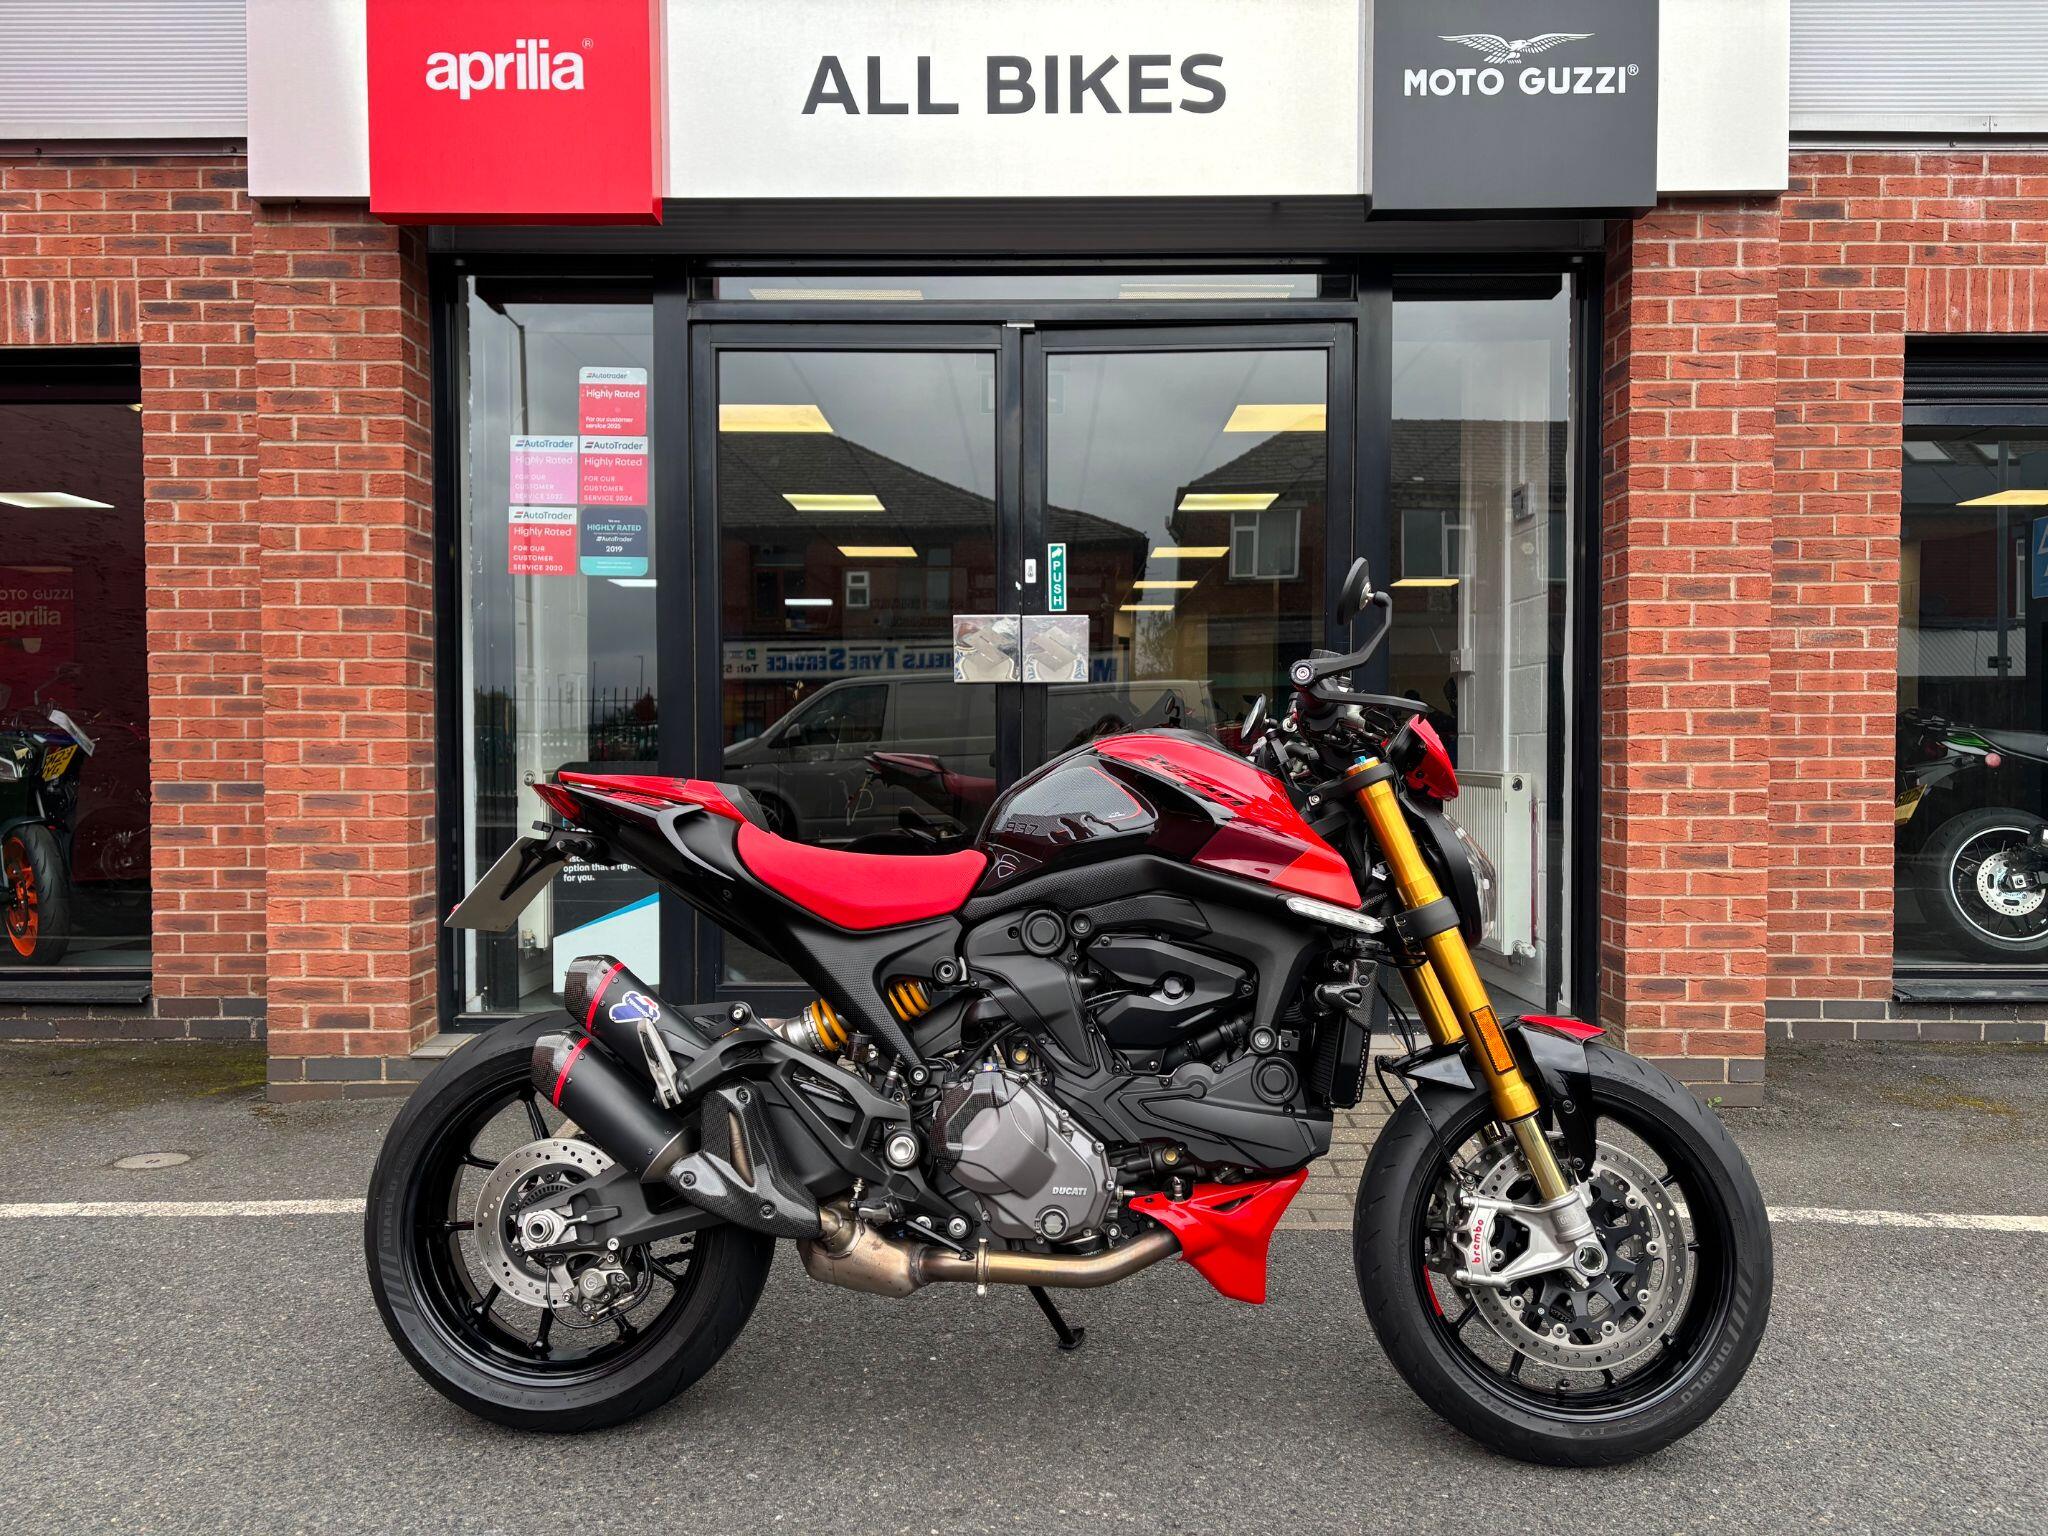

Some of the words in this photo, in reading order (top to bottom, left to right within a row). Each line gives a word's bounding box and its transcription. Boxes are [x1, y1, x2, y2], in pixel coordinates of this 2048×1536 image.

[425, 38, 585, 100] aprilia
[801, 55, 959, 115] ALL
[987, 53, 1226, 115] BIKES
[1403, 67, 1505, 97] MOTO
[1518, 66, 1627, 95] GUZZI
[586, 390, 613, 400] Highly
[614, 390, 640, 398] Rated
[524, 440, 573, 448] AutoTrader
[593, 441, 643, 450] AutoTrader
[515, 456, 543, 465] Highly
[545, 456, 573, 464] Rated
[584, 457, 613, 468] Highly
[615, 458, 642, 467] Rated
[523, 511, 572, 520] AutoTrader
[513, 526, 543, 537] Highly
[544, 527, 572, 536] Rated
[616, 524, 641, 532] RATED
[513, 554, 554, 562] CUSTOMER
[513, 563, 544, 571] SERVICE
[1052, 560, 1063, 606] PUSH
[33, 588, 74, 600] GUZZI
[0, 605, 61, 630] aprilia
[1004, 821, 1039, 836] 937
[563, 863, 590, 874] option
[563, 873, 576, 882] for
[577, 874, 595, 884] you.
[1051, 1186, 1088, 1196] DUCATI
[1471, 1219, 1484, 1263] brembo
[1680, 1341, 1734, 1404] DIABLO
